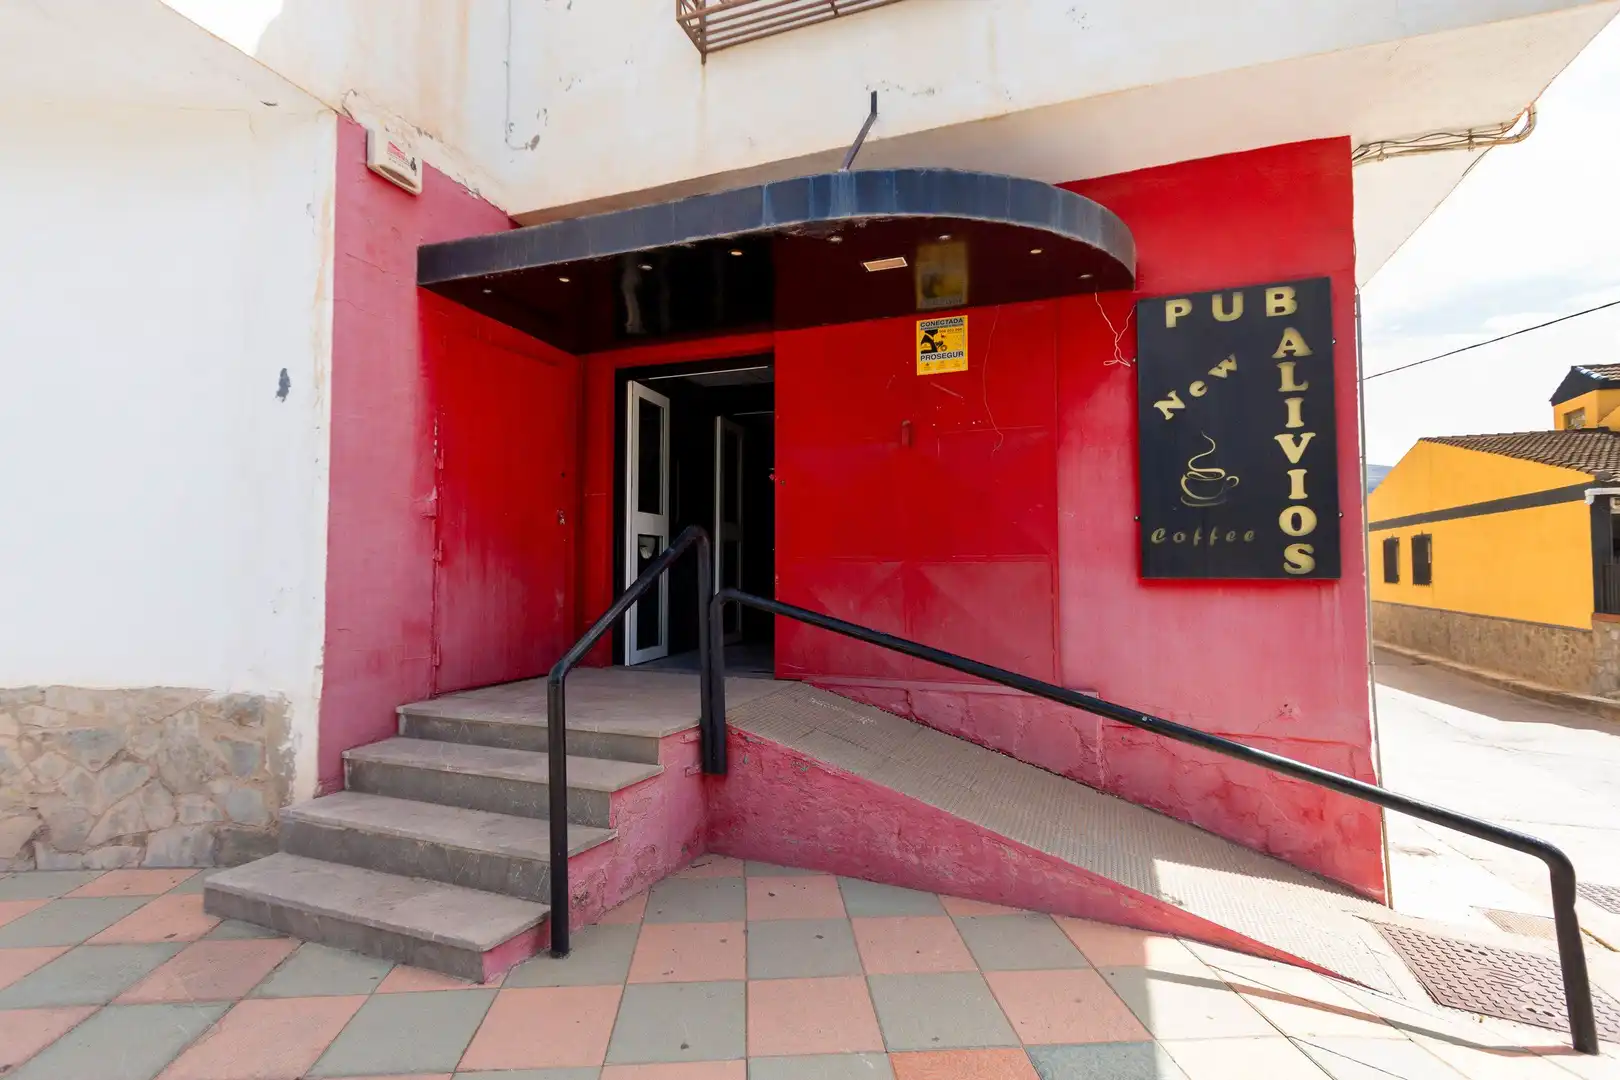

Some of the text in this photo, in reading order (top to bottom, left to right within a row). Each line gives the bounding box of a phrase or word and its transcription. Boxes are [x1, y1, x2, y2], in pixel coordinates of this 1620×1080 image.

[1165, 286, 1298, 328] PUB
[920, 317, 964, 328] CONECTADA
[920, 350, 964, 361] PROSEGUR
[1153, 353, 1238, 421] New
[1151, 526, 1255, 547] Coffee
